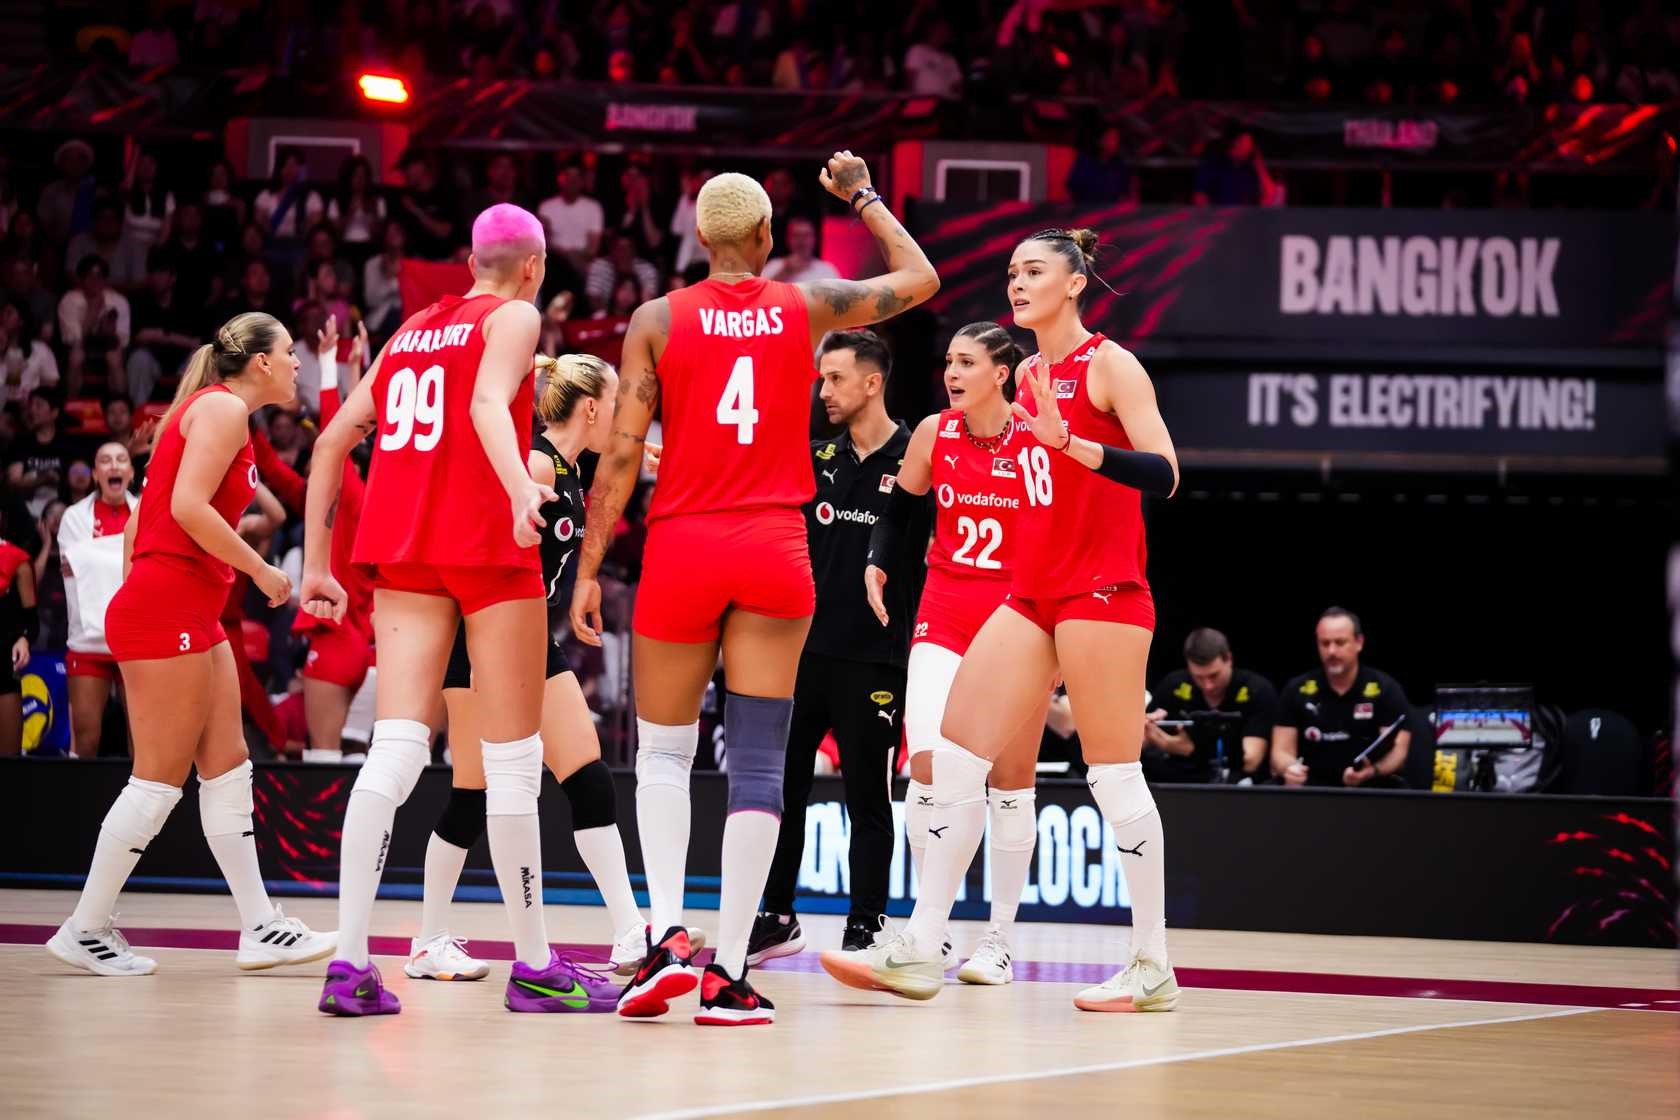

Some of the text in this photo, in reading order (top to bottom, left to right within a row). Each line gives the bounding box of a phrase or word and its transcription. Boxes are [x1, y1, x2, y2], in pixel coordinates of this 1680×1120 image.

[1280, 235, 1560, 317] BANGKOK
[699, 306, 784, 338] VARGAS
[380, 364, 445, 451] 99
[716, 356, 759, 444] 4
[1248, 373, 1596, 430] IT'S ELECTRIFYING!
[957, 492, 1020, 509] vodafone
[1017, 446, 1053, 507] 18
[952, 516, 1003, 569] 22
[179, 632, 191, 651] 3
